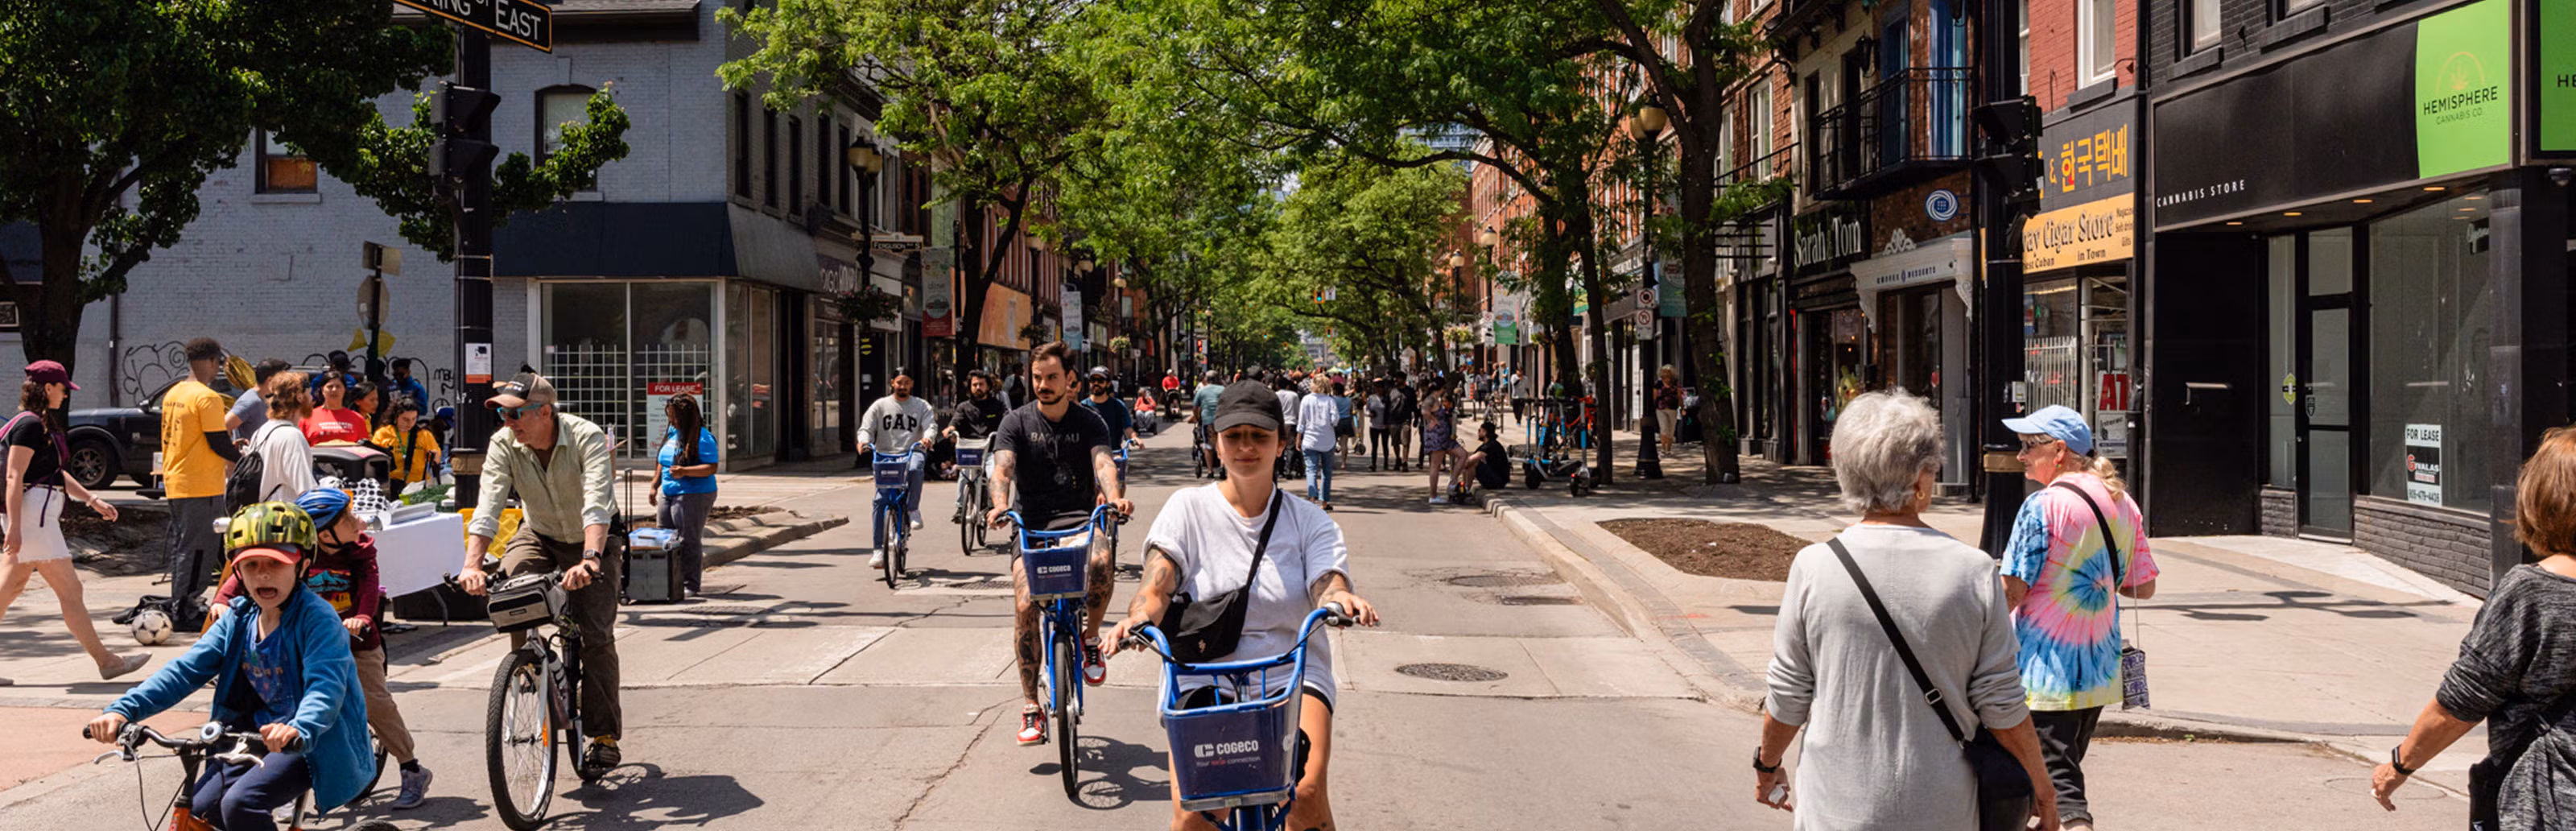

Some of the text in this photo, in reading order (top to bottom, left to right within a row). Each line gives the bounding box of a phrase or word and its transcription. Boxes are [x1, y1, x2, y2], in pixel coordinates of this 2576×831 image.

[495, 0, 542, 40] EAST
[2423, 85, 2499, 116] HEMISPHERE
[2435, 110, 2471, 125] CANNABIS
[2061, 122, 2128, 193] 한국택배
[2157, 179, 2245, 208] CANNABIS STORE
[1794, 222, 1827, 267] Sarah
[1831, 214, 1861, 258] Tom
[2043, 218, 2075, 254] Cigar
[2078, 209, 2114, 242] Store
[2087, 249, 2106, 260] Town
[1908, 266, 1936, 278] DESSERTS
[654, 385, 696, 393] FOR LEASE
[883, 413, 918, 432] GAP
[2407, 428, 2440, 442] FOR LEASE
